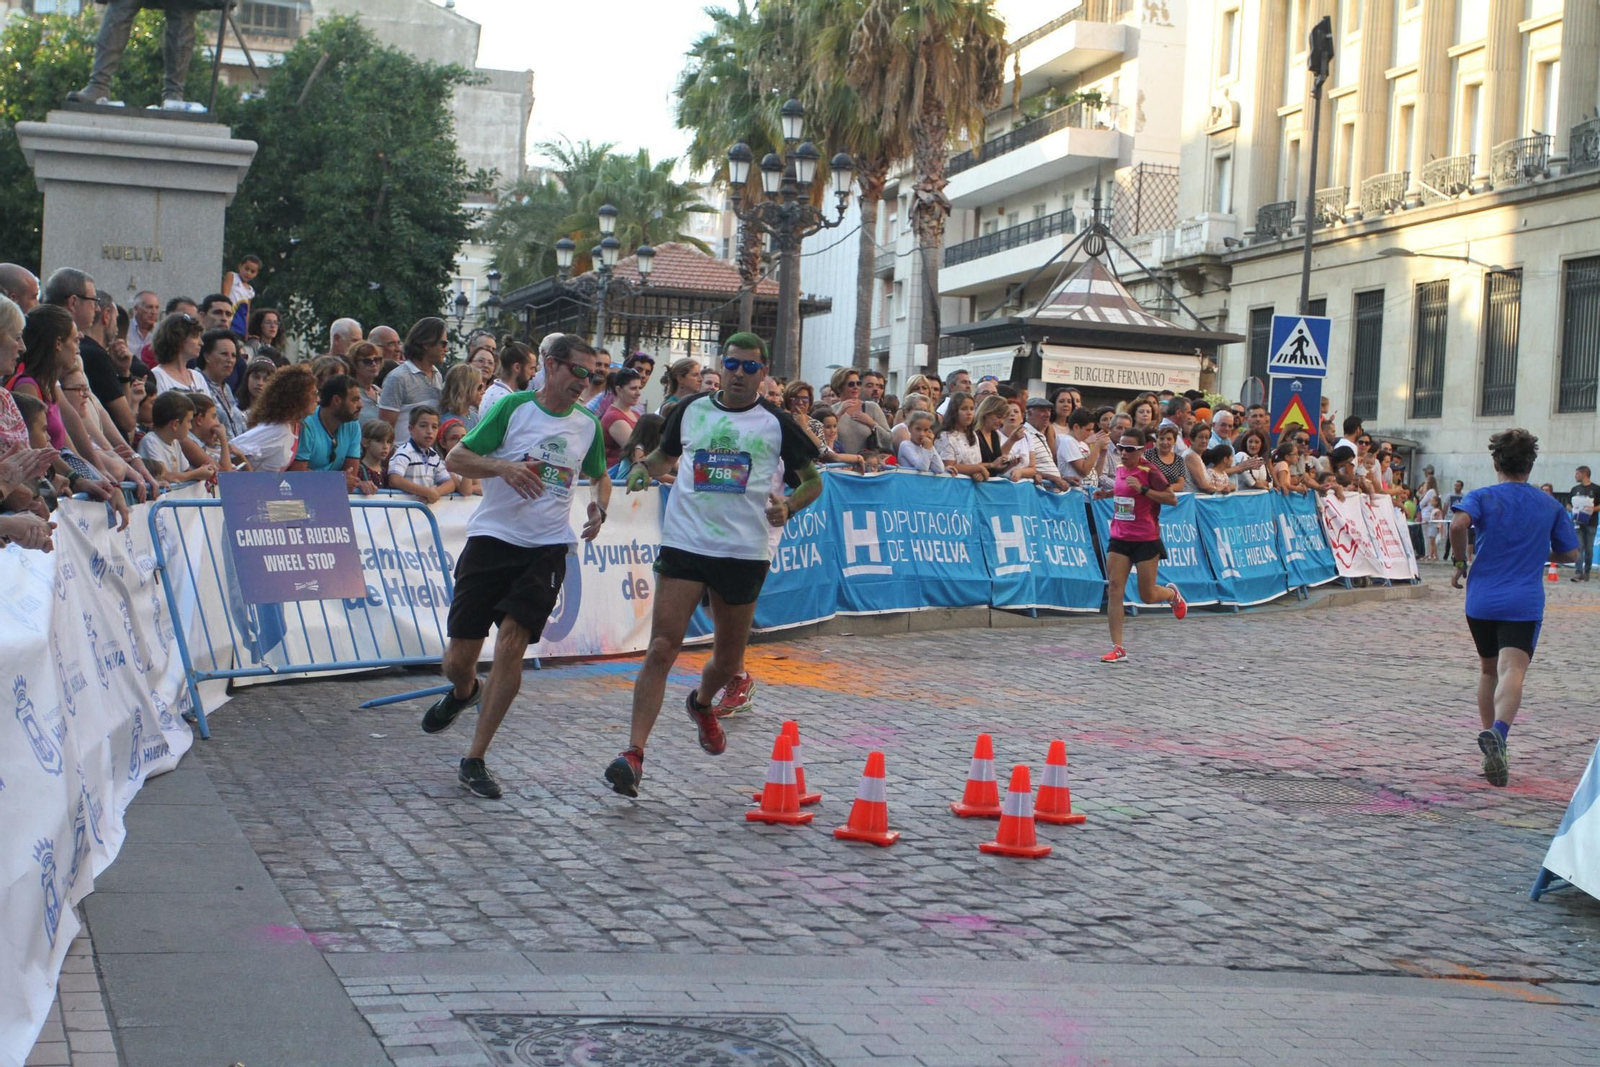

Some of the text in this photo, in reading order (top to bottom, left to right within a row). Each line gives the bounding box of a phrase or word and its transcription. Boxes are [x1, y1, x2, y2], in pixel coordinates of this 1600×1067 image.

[102, 244, 163, 263] HUELVA
[126, 276, 137, 291] A
[1073, 366, 1166, 388] BURGUER FERNANDO
[543, 466, 560, 481] 32
[707, 467, 733, 480] 758
[881, 509, 973, 536] DIPUTACIÓN
[235, 526, 350, 547] CAMBIO DE RUEDAS
[263, 553, 336, 572] WHEEL STOP
[887, 540, 971, 564] DE HUELVA
[1244, 544, 1278, 567] HUELVA
[384, 577, 454, 608] Huelv
[621, 571, 650, 601] de
